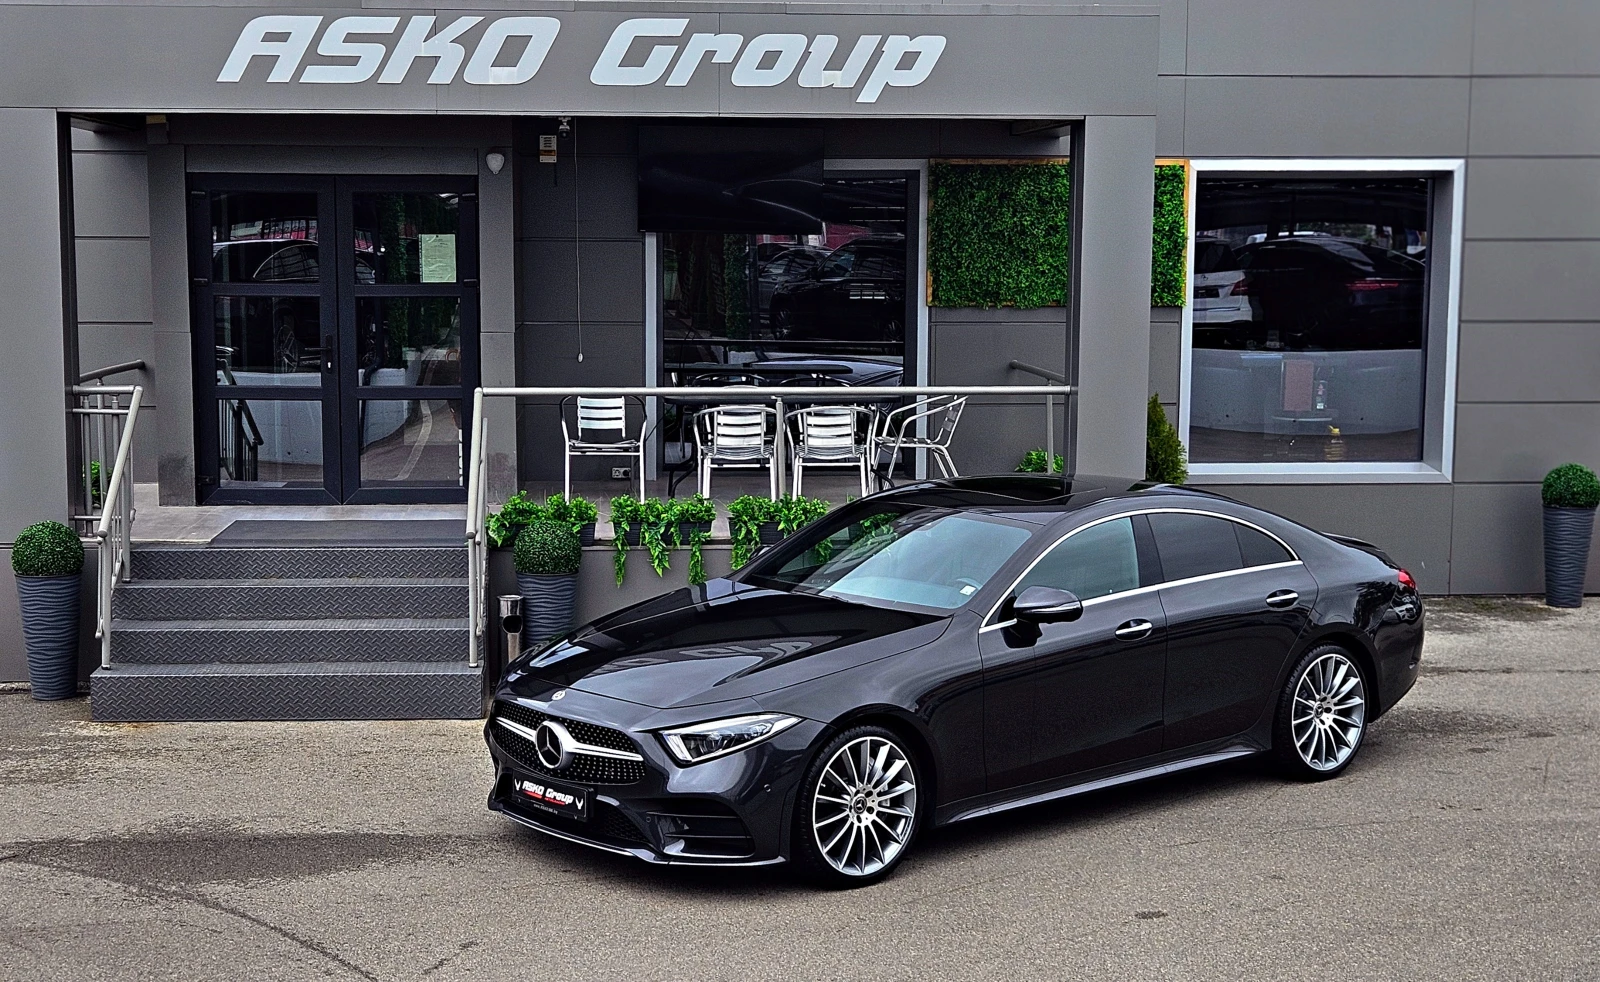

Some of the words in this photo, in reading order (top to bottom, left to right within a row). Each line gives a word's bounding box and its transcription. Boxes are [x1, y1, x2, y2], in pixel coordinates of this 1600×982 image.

[216, 16, 562, 85] ASKO
[589, 18, 947, 103] Group
[522, 781, 544, 795] ASKO
[546, 788, 574, 804] Group
